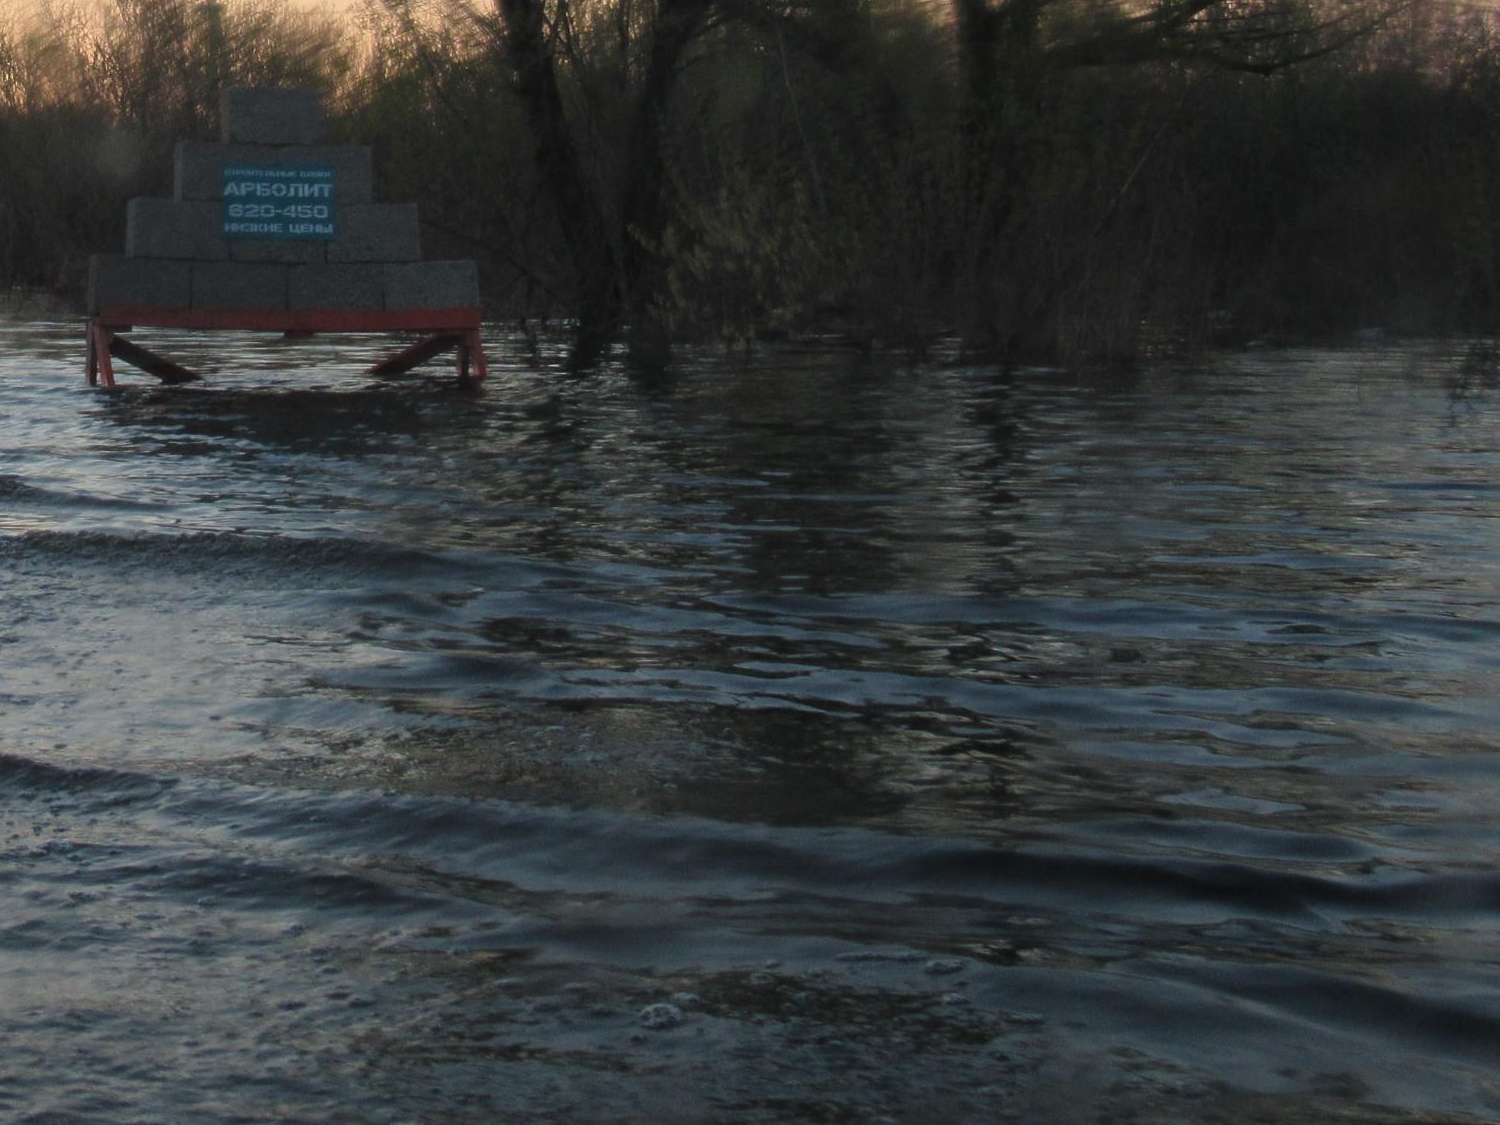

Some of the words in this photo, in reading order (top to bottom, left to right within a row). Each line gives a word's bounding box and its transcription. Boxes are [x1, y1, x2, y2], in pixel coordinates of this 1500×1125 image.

[224, 182, 333, 197] АРБОЛИТ
[228, 204, 329, 219] 620-450
[224, 222, 283, 233] НИЗКИЕ
[288, 223, 334, 235] ЦЕНЫ
